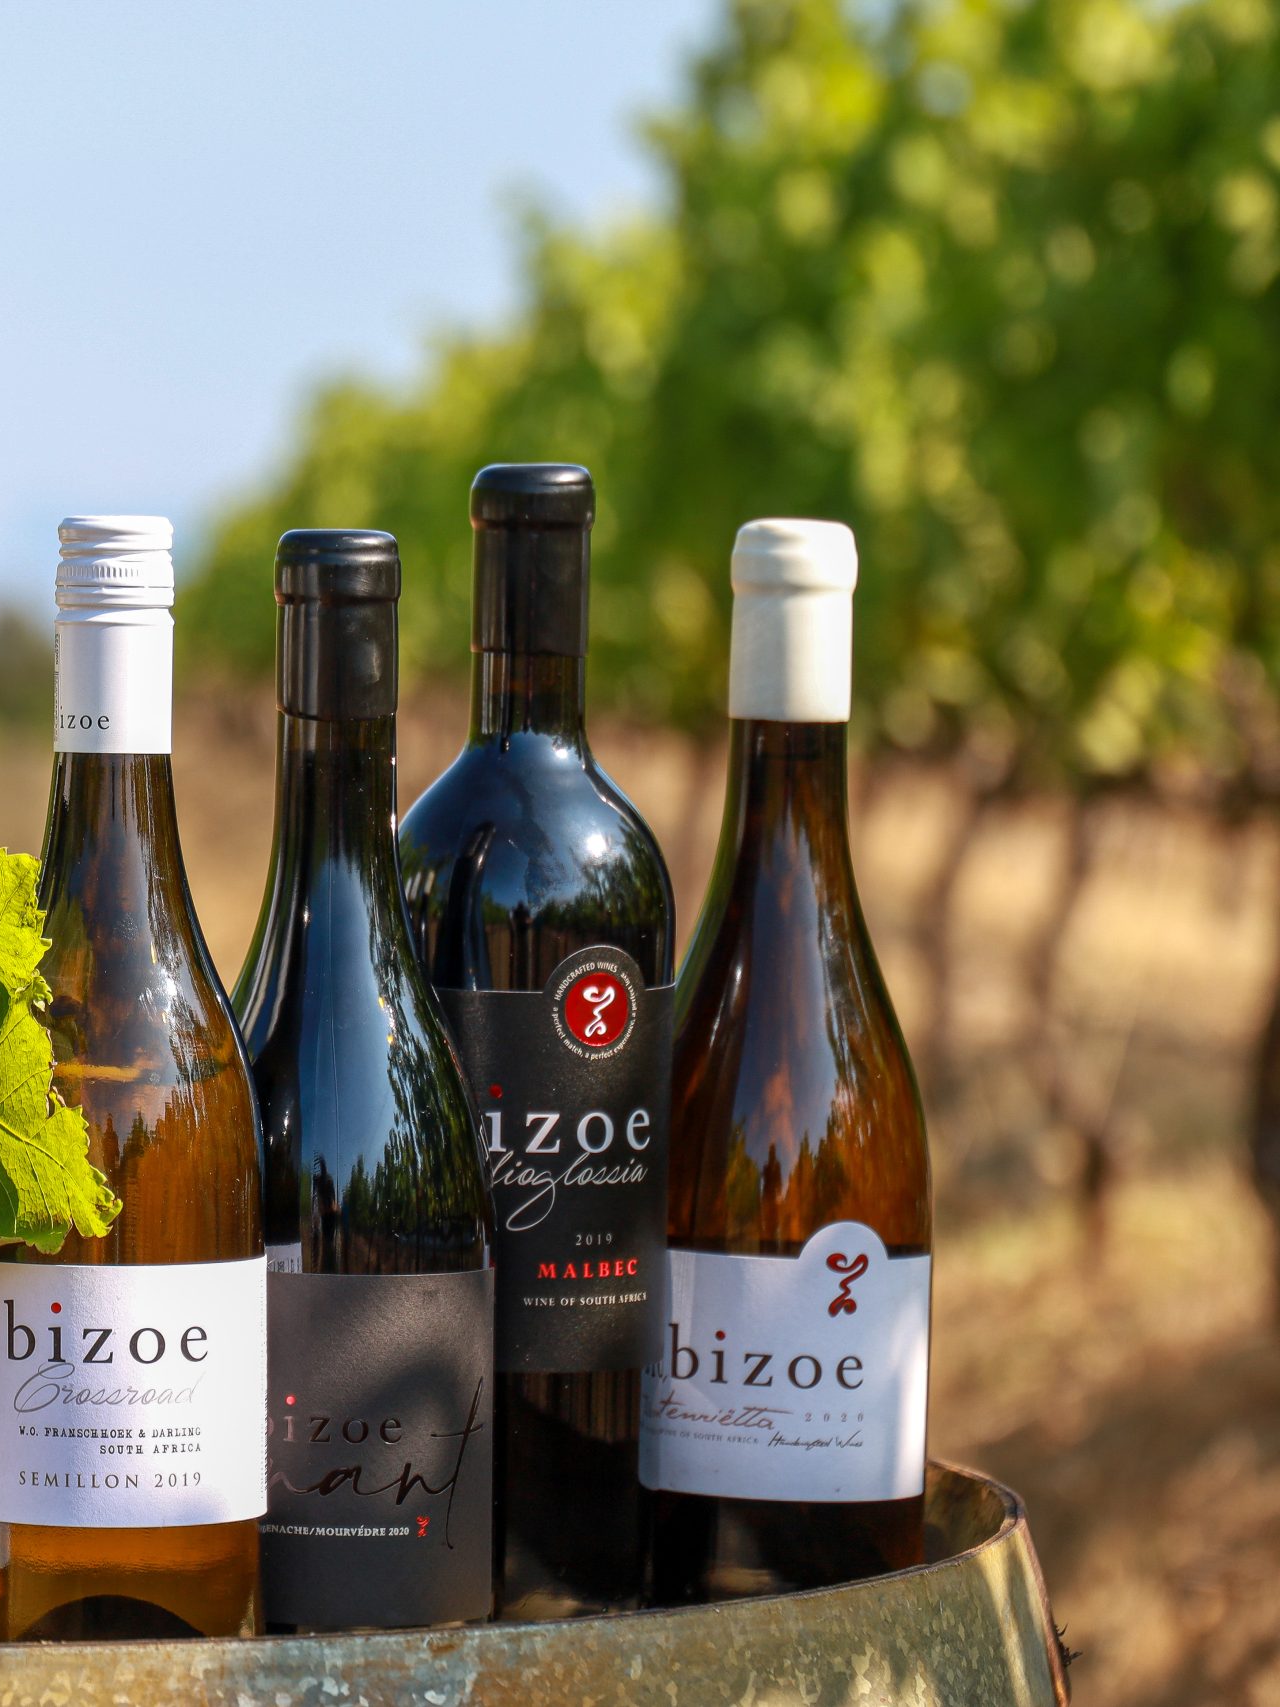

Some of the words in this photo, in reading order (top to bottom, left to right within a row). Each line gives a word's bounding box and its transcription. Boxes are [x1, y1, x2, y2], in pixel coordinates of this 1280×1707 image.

[554, 962, 596, 1001] HANDCRAFTED
[597, 961, 619, 973] WINES
[552, 1013, 566, 1040] perfect
[563, 1037, 584, 1058] match,
[590, 1051, 614, 1061] perfect
[480, 1083, 651, 1153] izoe
[575, 1233, 613, 1246] 2019
[537, 1257, 638, 1280] MALBEC
[523, 1297, 556, 1307] WINE
[560, 1297, 575, 1307] OF
[579, 1295, 616, 1306] SOUTH
[618, 1291, 648, 1304] AFRICA
[3, 1299, 208, 1364] bizoe
[668, 1323, 864, 1390] bizoe
[13, 1362, 207, 1420] Crossroad
[267, 1395, 402, 1445] izoe
[805, 1412, 864, 1423] 2020
[19, 1425, 40, 1438] W.O.
[44, 1427, 133, 1439] FRANSCHHOEK
[138, 1429, 147, 1439] &
[152, 1427, 202, 1439] DARLING
[693, 1432, 723, 1442] SOUTH
[99, 1444, 144, 1455] SOUTH
[153, 1443, 202, 1454] AFRICA
[19, 1470, 139, 1489] SEMILLON
[154, 1472, 202, 1489] 2019
[388, 1526, 410, 1537] 2020
